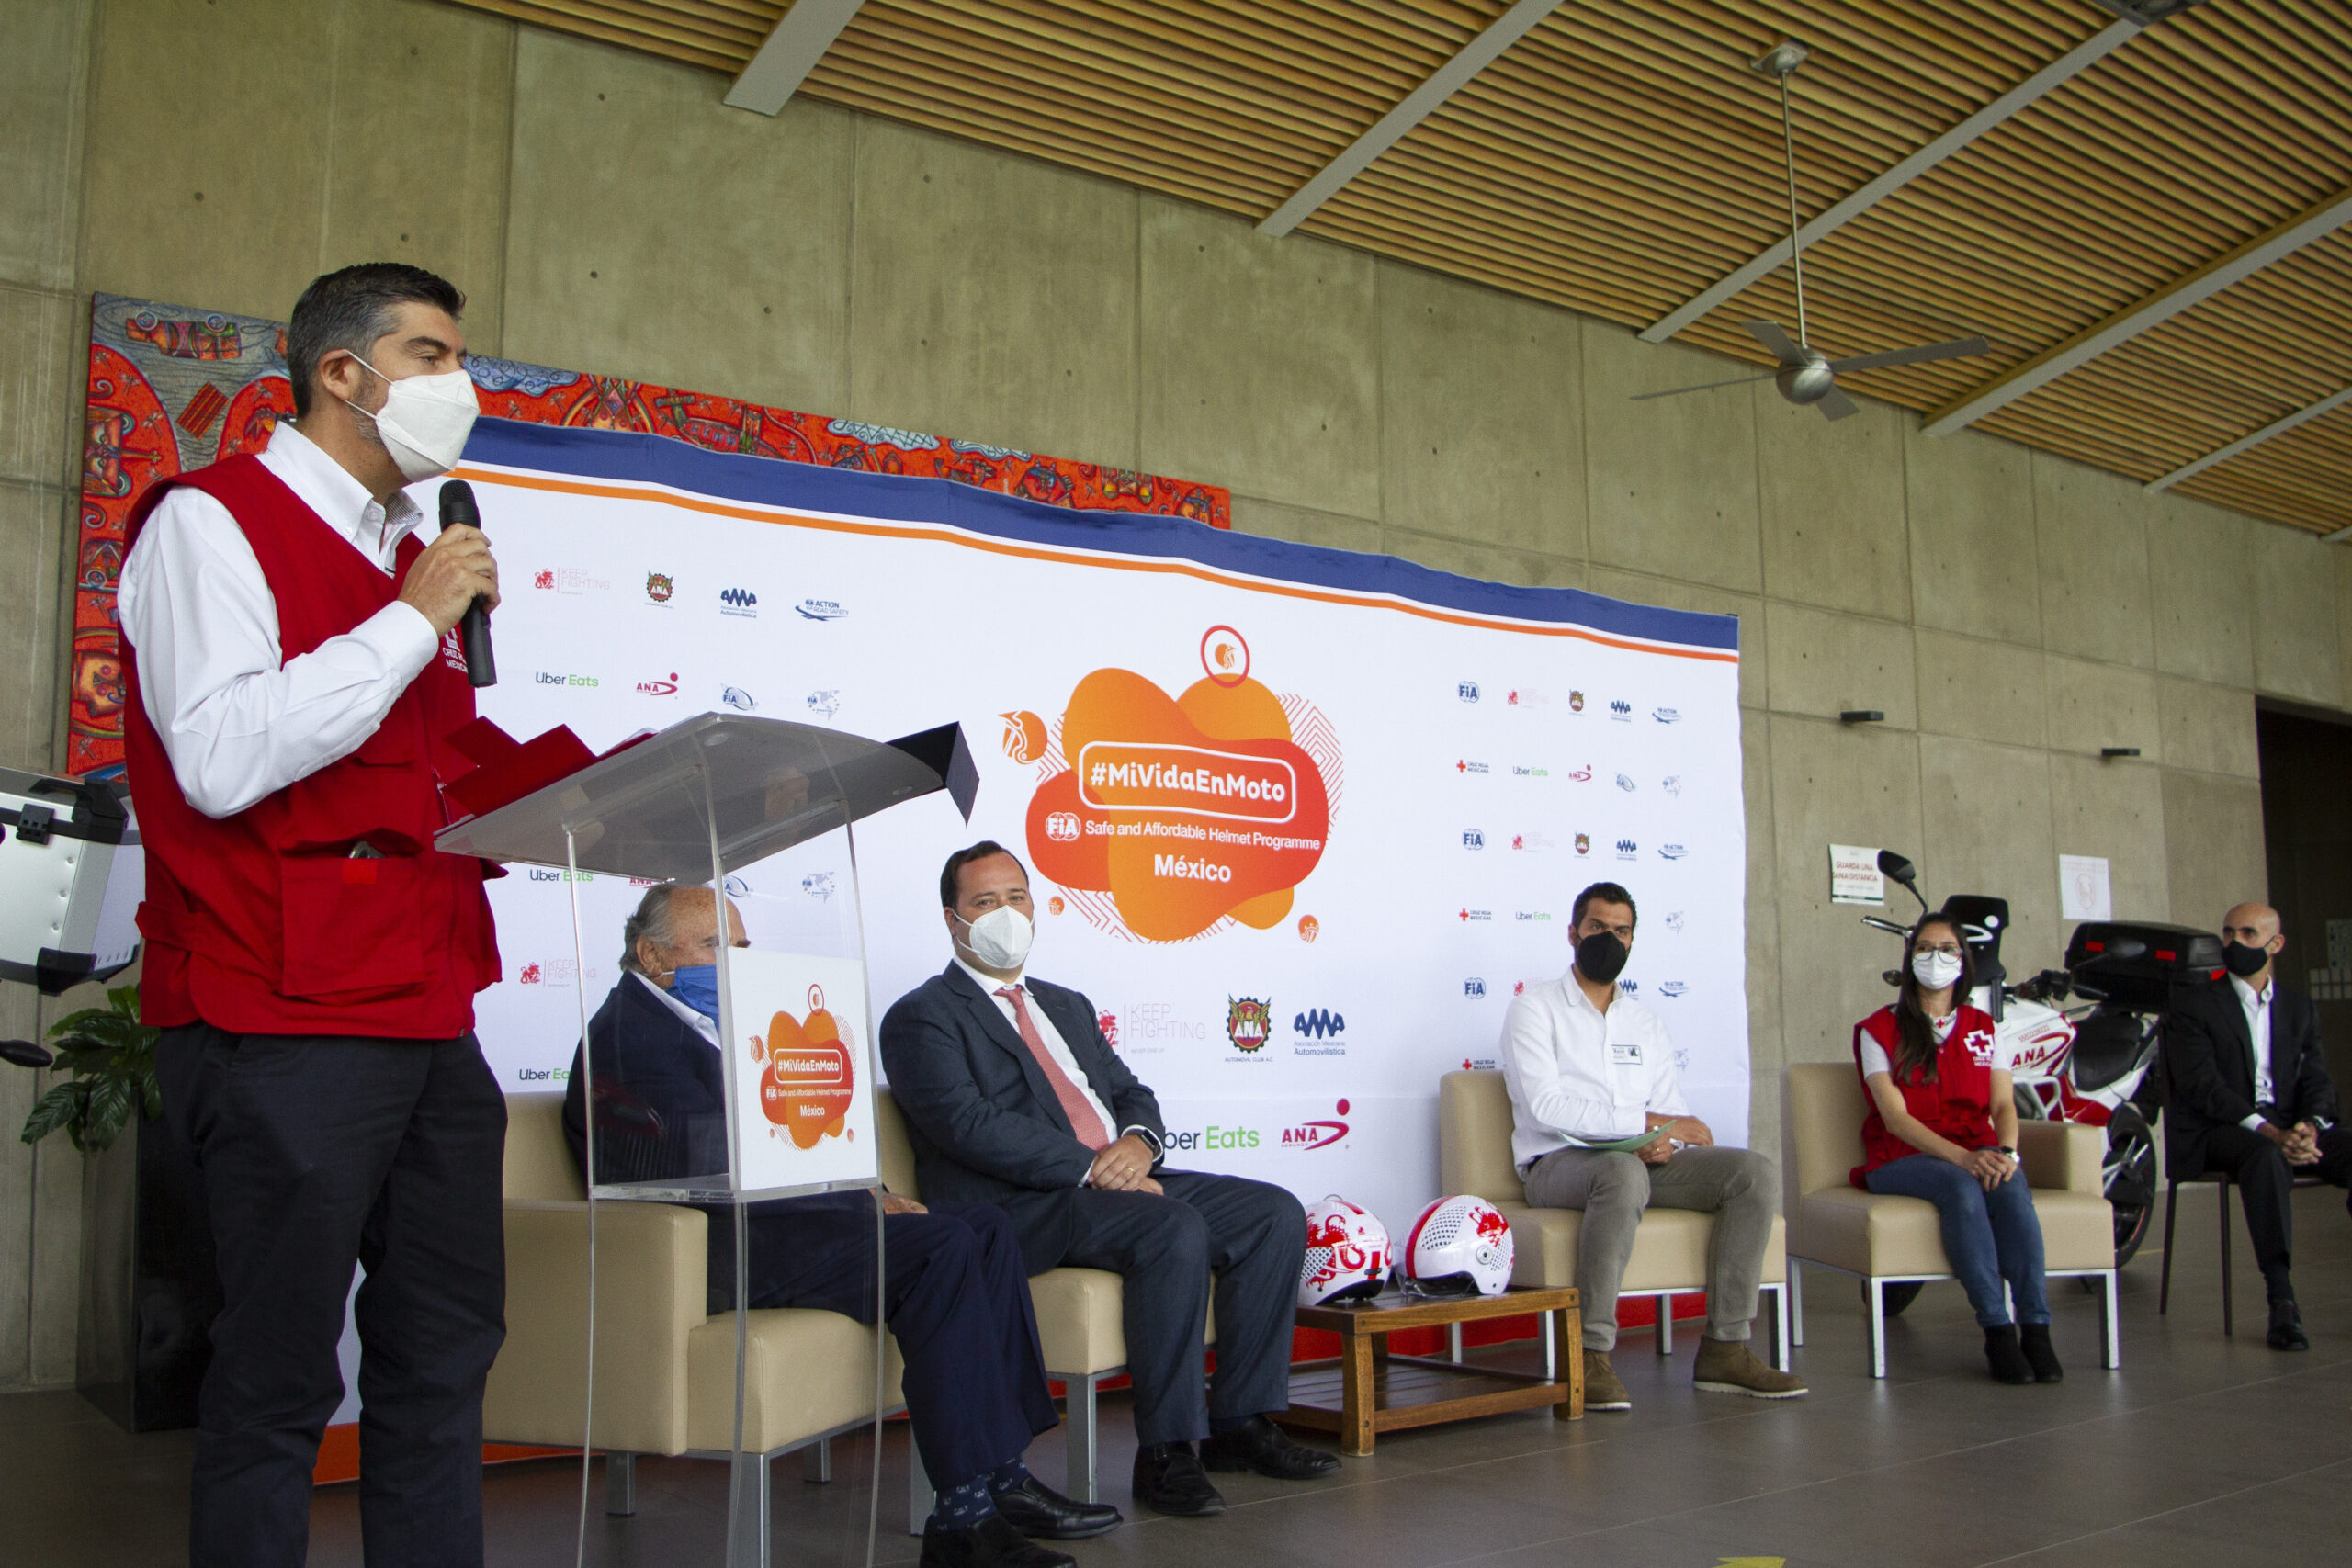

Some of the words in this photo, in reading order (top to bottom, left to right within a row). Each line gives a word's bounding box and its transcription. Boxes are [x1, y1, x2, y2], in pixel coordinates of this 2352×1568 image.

[815, 600, 840, 609] ACTION
[535, 671, 567, 685] Uber
[568, 673, 600, 688] Eats
[636, 682, 660, 693] ANA
[1512, 765, 1531, 776] Uber
[1531, 767, 1549, 777] Eats
[1090, 761, 1286, 802] #MiVidaEnMoto
[1085, 819, 1115, 836] Safe
[1116, 821, 1141, 836] and
[1142, 821, 1207, 840] Affordable
[1208, 828, 1251, 846] Helmet
[1252, 831, 1320, 852] Programme
[529, 868, 560, 882] Uber
[1153, 853, 1232, 883] México
[1515, 910, 1533, 920] Uber
[1533, 911, 1551, 920] Eats
[1130, 1002, 1170, 1021] KEEP
[1130, 1021, 1206, 1040] FIGHTING
[1234, 1021, 1263, 1038] ANA
[2010, 1044, 2045, 1067] ANA
[777, 1058, 840, 1073] #MiVidaEnMoto
[519, 1067, 550, 1081] Uber
[552, 1067, 571, 1081] Ea
[796, 1088, 816, 1097] Affordable
[830, 1088, 852, 1098] Programme
[799, 1104, 825, 1117] México
[1163, 1126, 1201, 1150] ber
[1205, 1125, 1261, 1149] Eats
[1281, 1127, 1319, 1143] ANA
